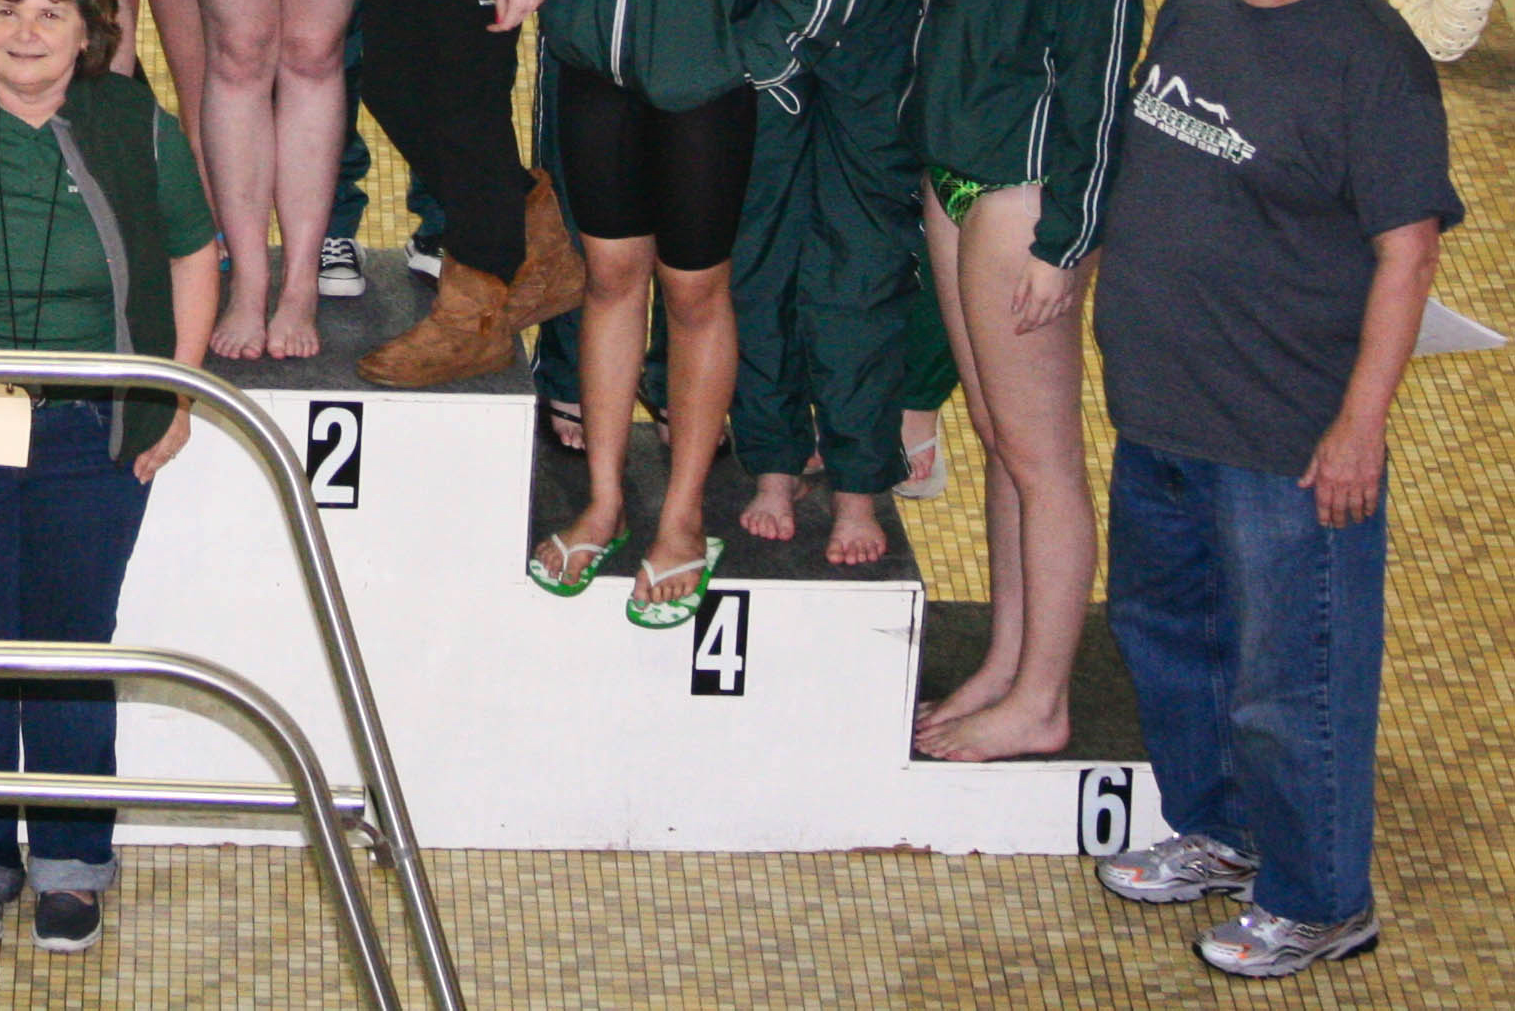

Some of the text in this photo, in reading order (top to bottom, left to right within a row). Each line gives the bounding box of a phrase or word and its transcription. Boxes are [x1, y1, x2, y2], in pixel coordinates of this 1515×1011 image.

[310, 406, 359, 504] 2
[695, 595, 743, 691] 4
[1081, 765, 1128, 857] 6
